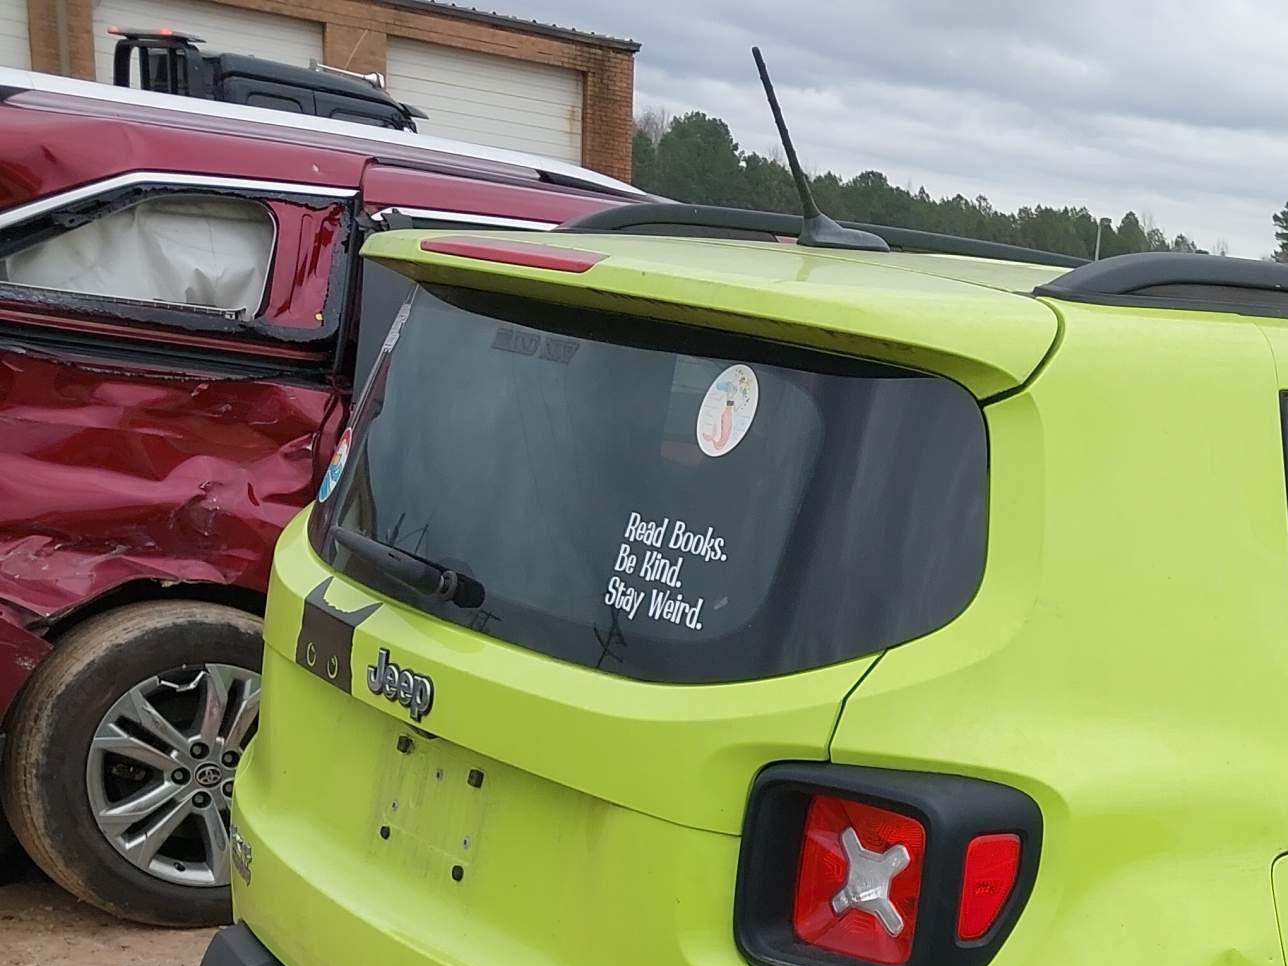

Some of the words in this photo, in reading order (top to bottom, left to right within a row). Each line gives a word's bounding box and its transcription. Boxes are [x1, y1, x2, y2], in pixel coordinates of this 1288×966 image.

[624, 511, 670, 549] Read
[668, 520, 728, 562] Books.
[614, 543, 638, 574] Be
[639, 550, 684, 588] Kind.
[604, 576, 646, 621] Stay
[648, 588, 704, 630] Weird.
[366, 648, 435, 724] Jeep
